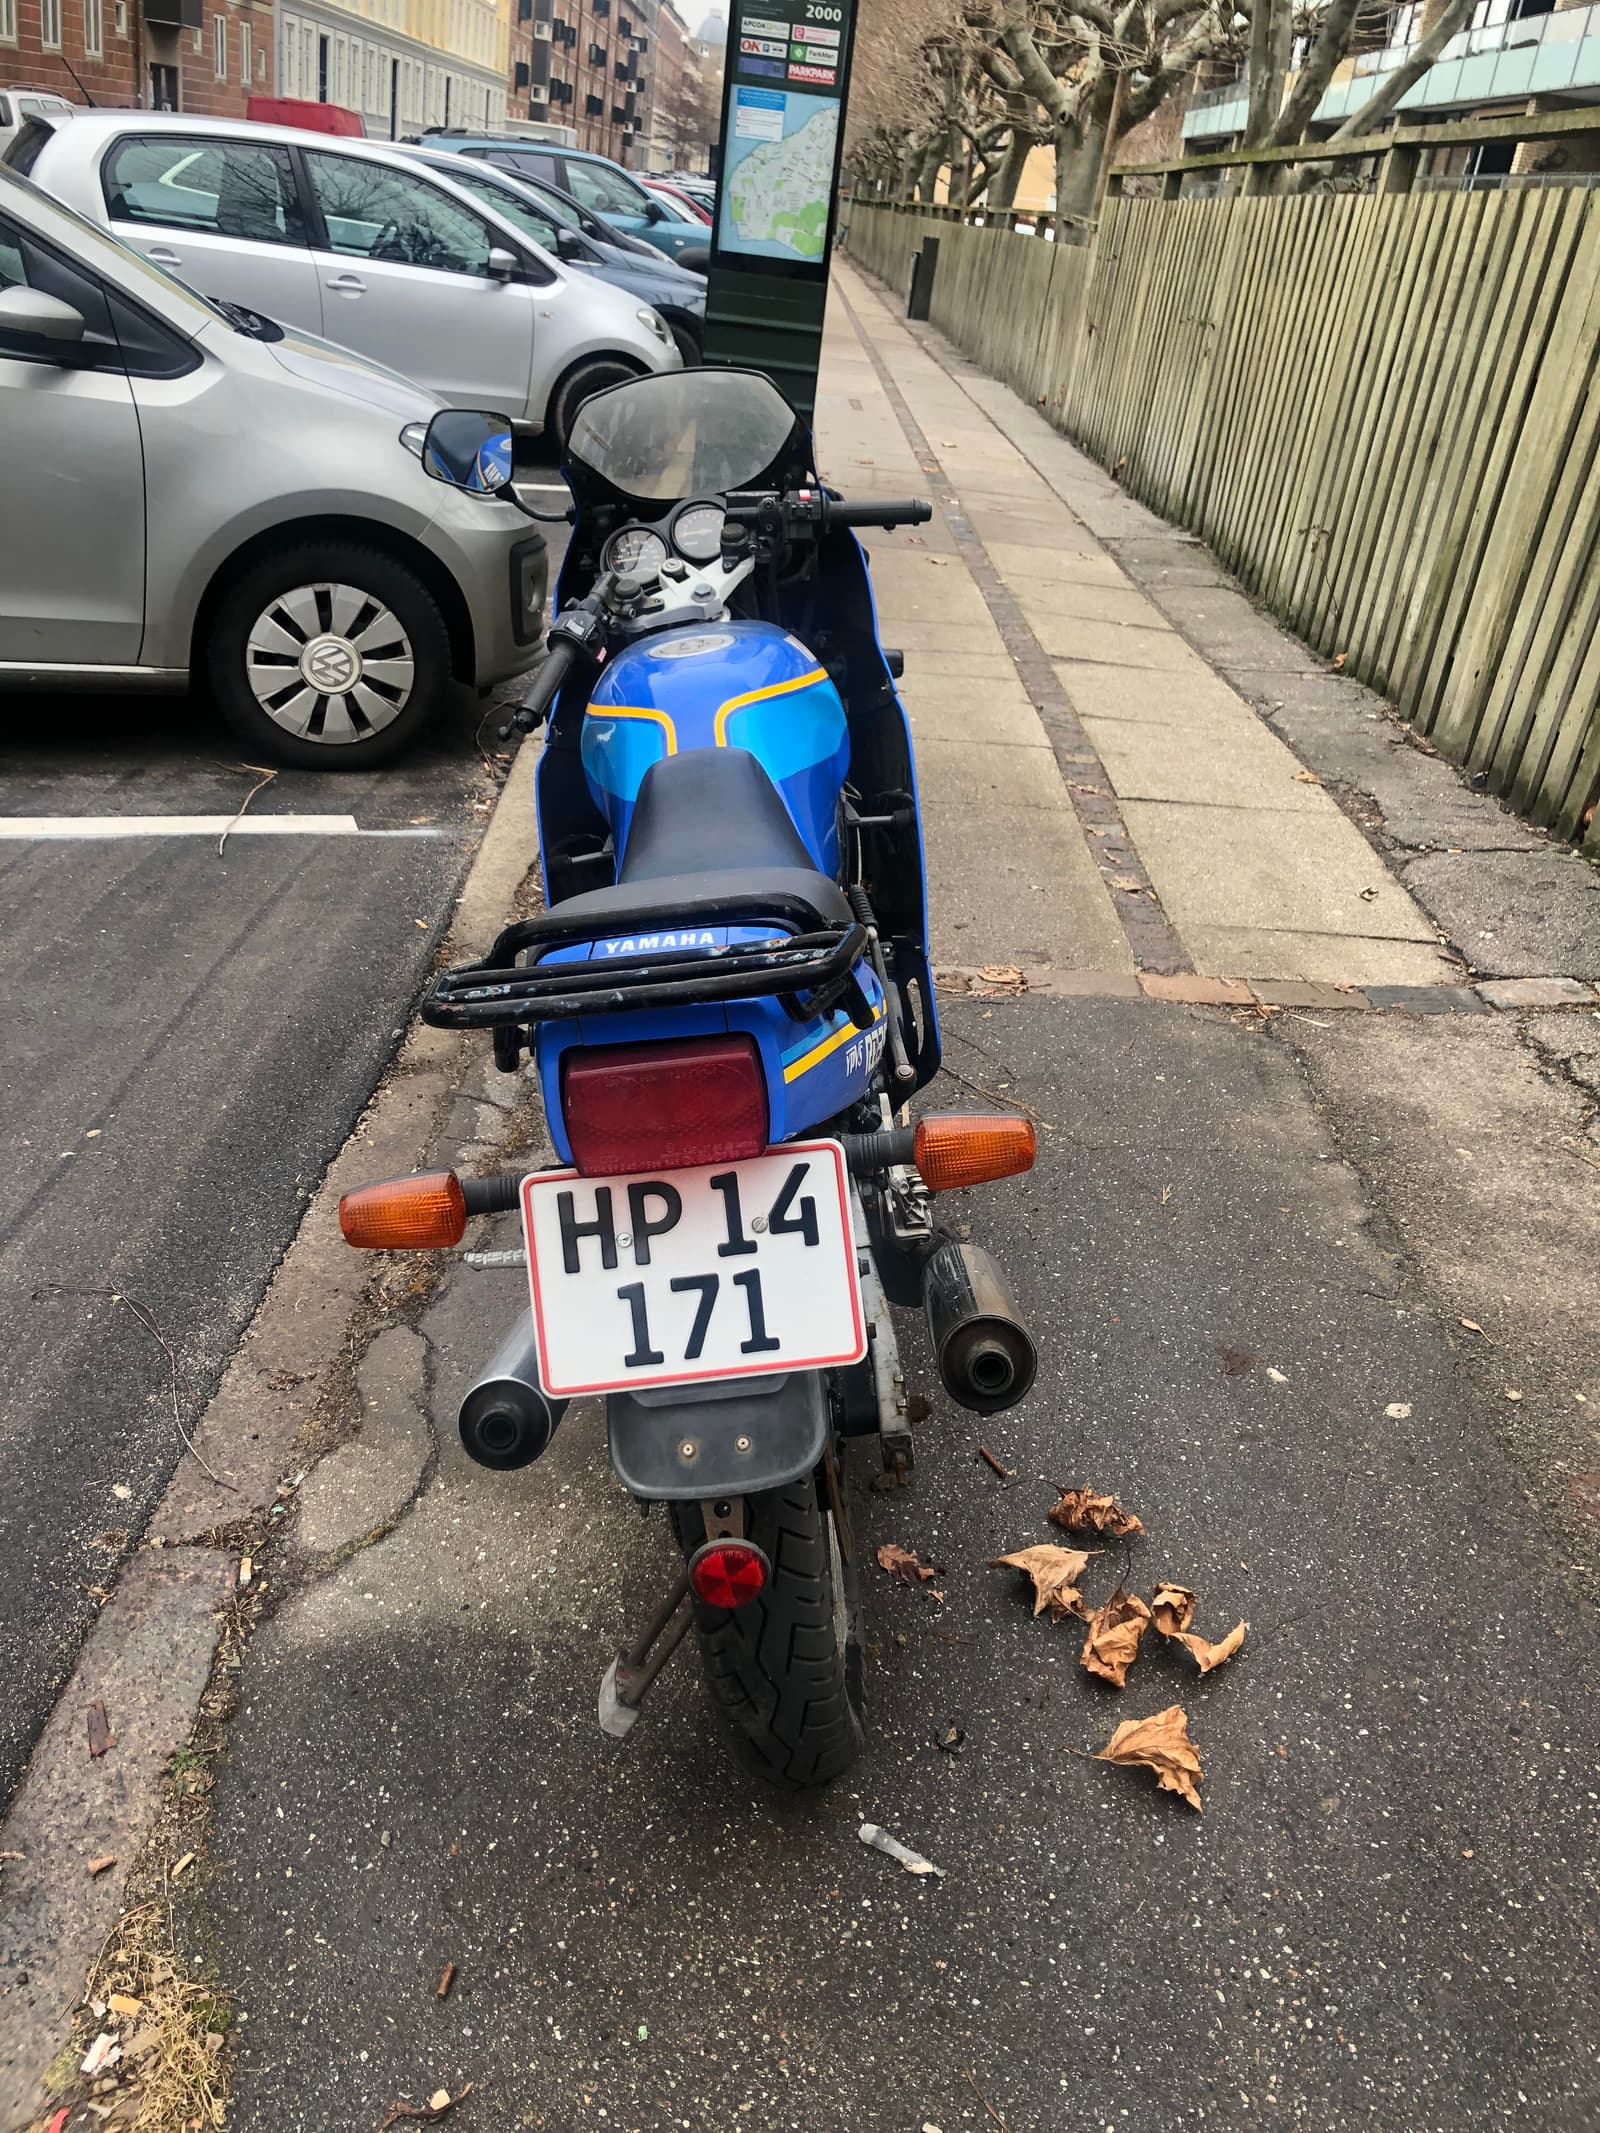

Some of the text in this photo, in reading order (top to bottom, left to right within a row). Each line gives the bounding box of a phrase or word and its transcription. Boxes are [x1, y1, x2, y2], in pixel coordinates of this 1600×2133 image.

[806, 4, 842, 22] 2000
[742, 39, 761, 53] OK
[808, 49, 835, 59] ParkMan
[789, 64, 836, 81] PARKPARK
[606, 931, 715, 954] YAMAHA
[557, 1162, 820, 1274] HP 14
[617, 1267, 781, 1368] 171
